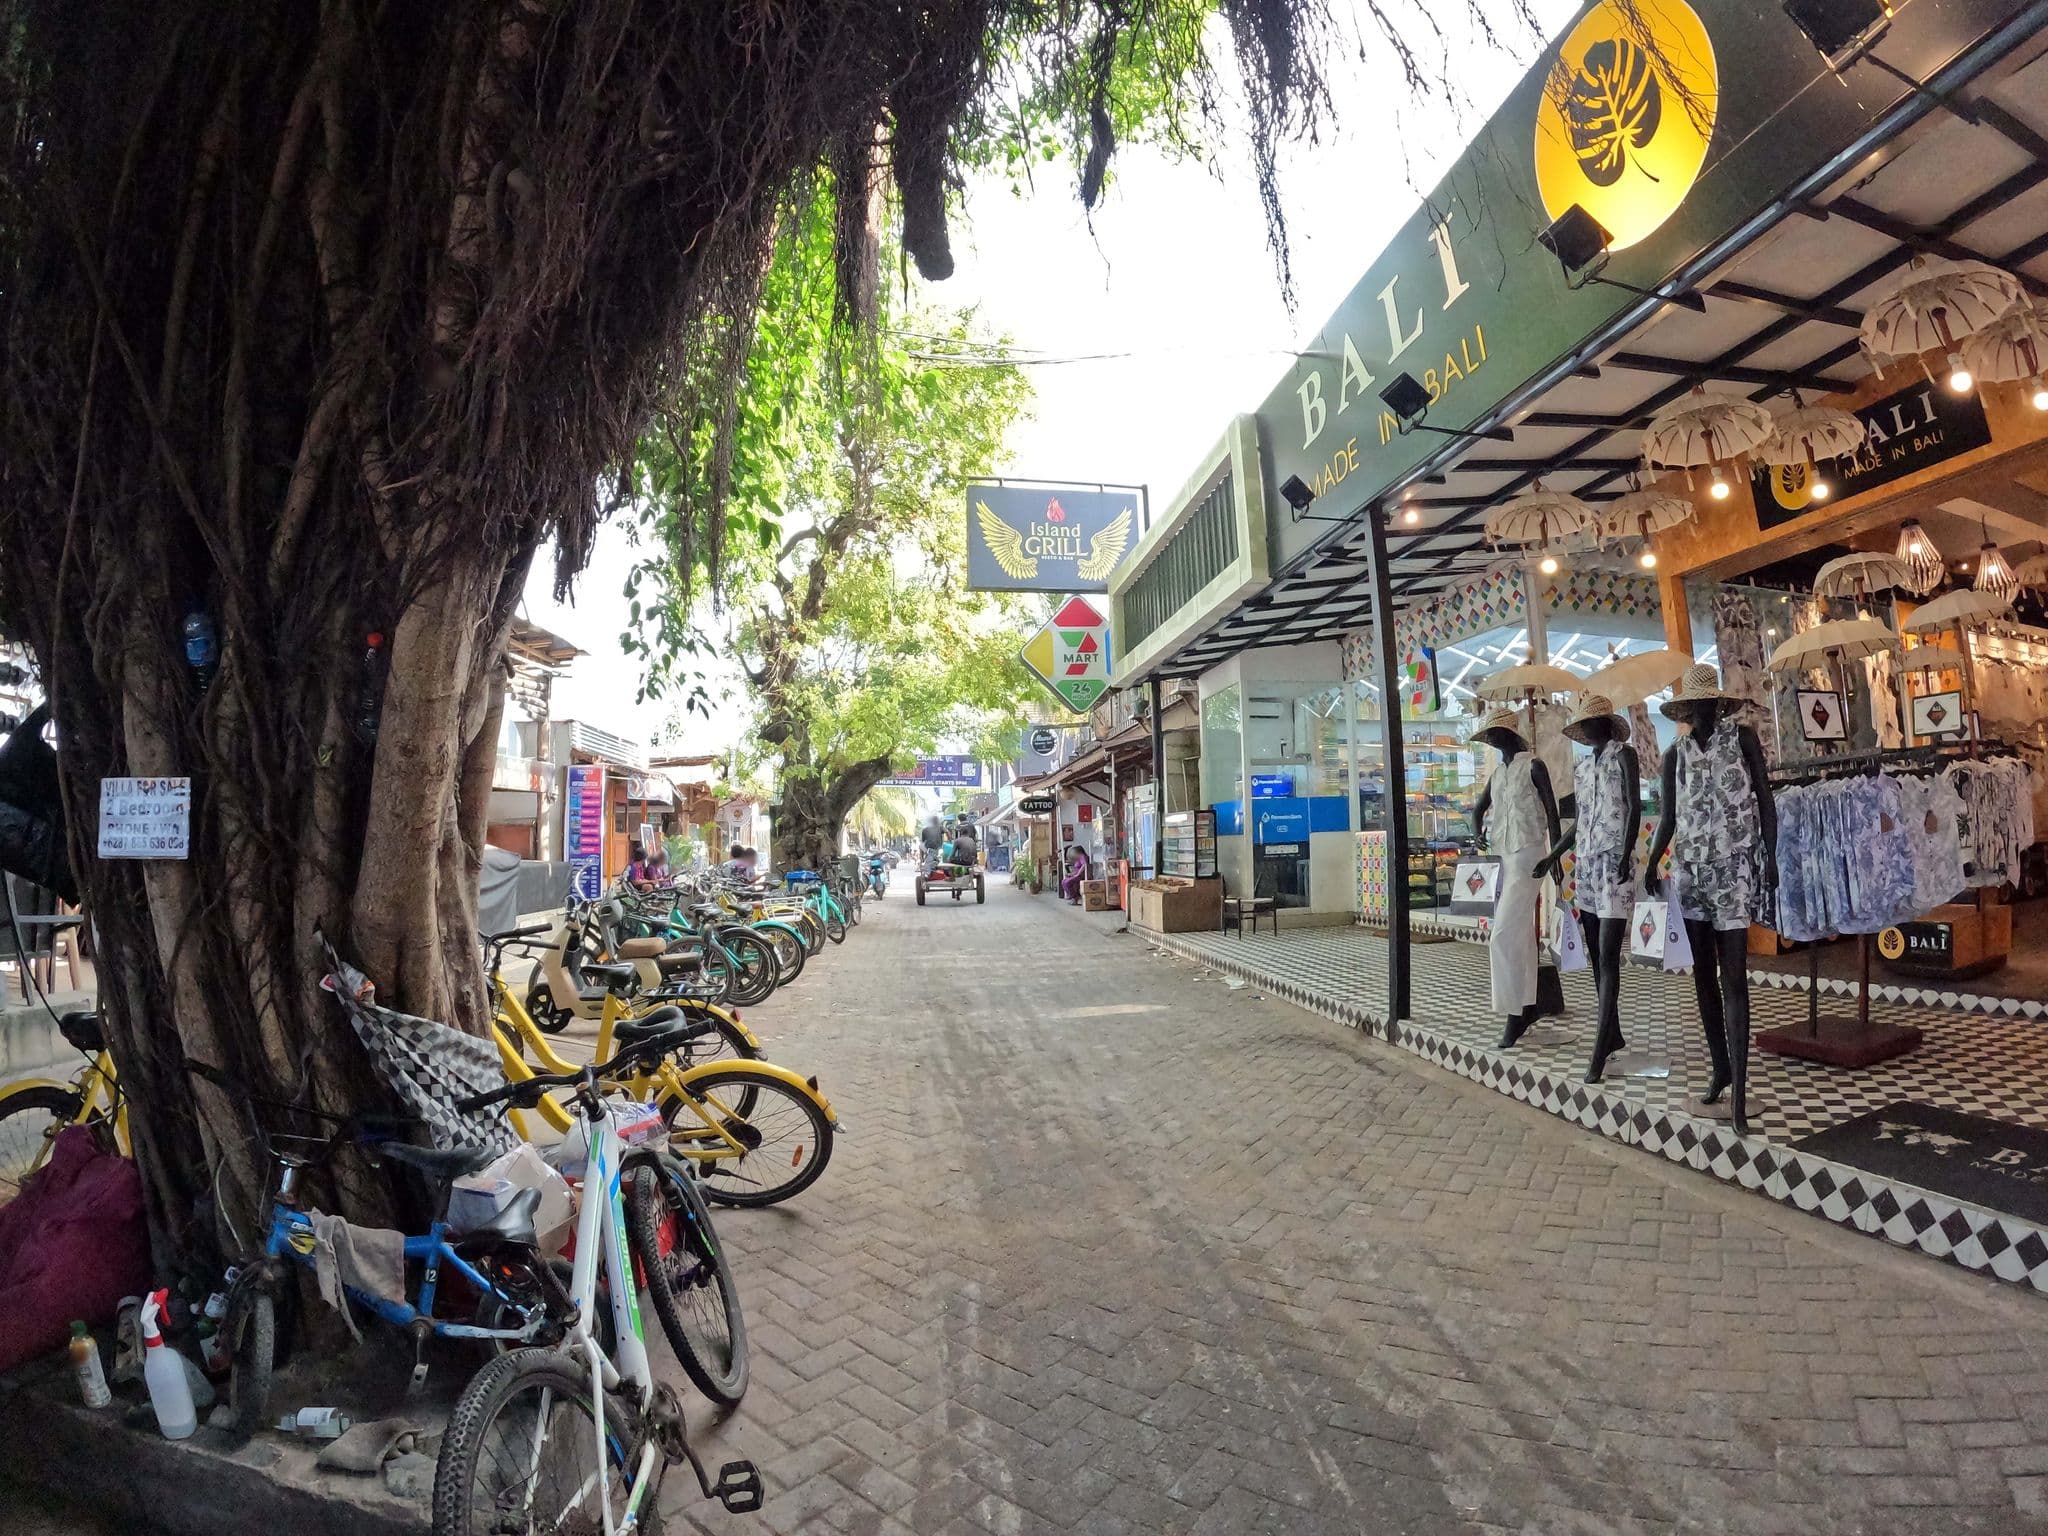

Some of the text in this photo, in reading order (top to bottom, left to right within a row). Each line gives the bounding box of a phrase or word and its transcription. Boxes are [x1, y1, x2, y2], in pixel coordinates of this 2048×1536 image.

[1296, 212, 1471, 451] BALI
[1422, 323, 1488, 407] BALI
[1891, 445, 1906, 461] IN
[1913, 429, 1945, 452] BALI
[1030, 521, 1081, 538] Island
[1025, 536, 1089, 557] GRILL
[1063, 653, 1099, 663] MART
[1072, 682, 1092, 694] 24
[1023, 801, 1054, 809] TATTOO
[1909, 933, 1947, 950] BALI
